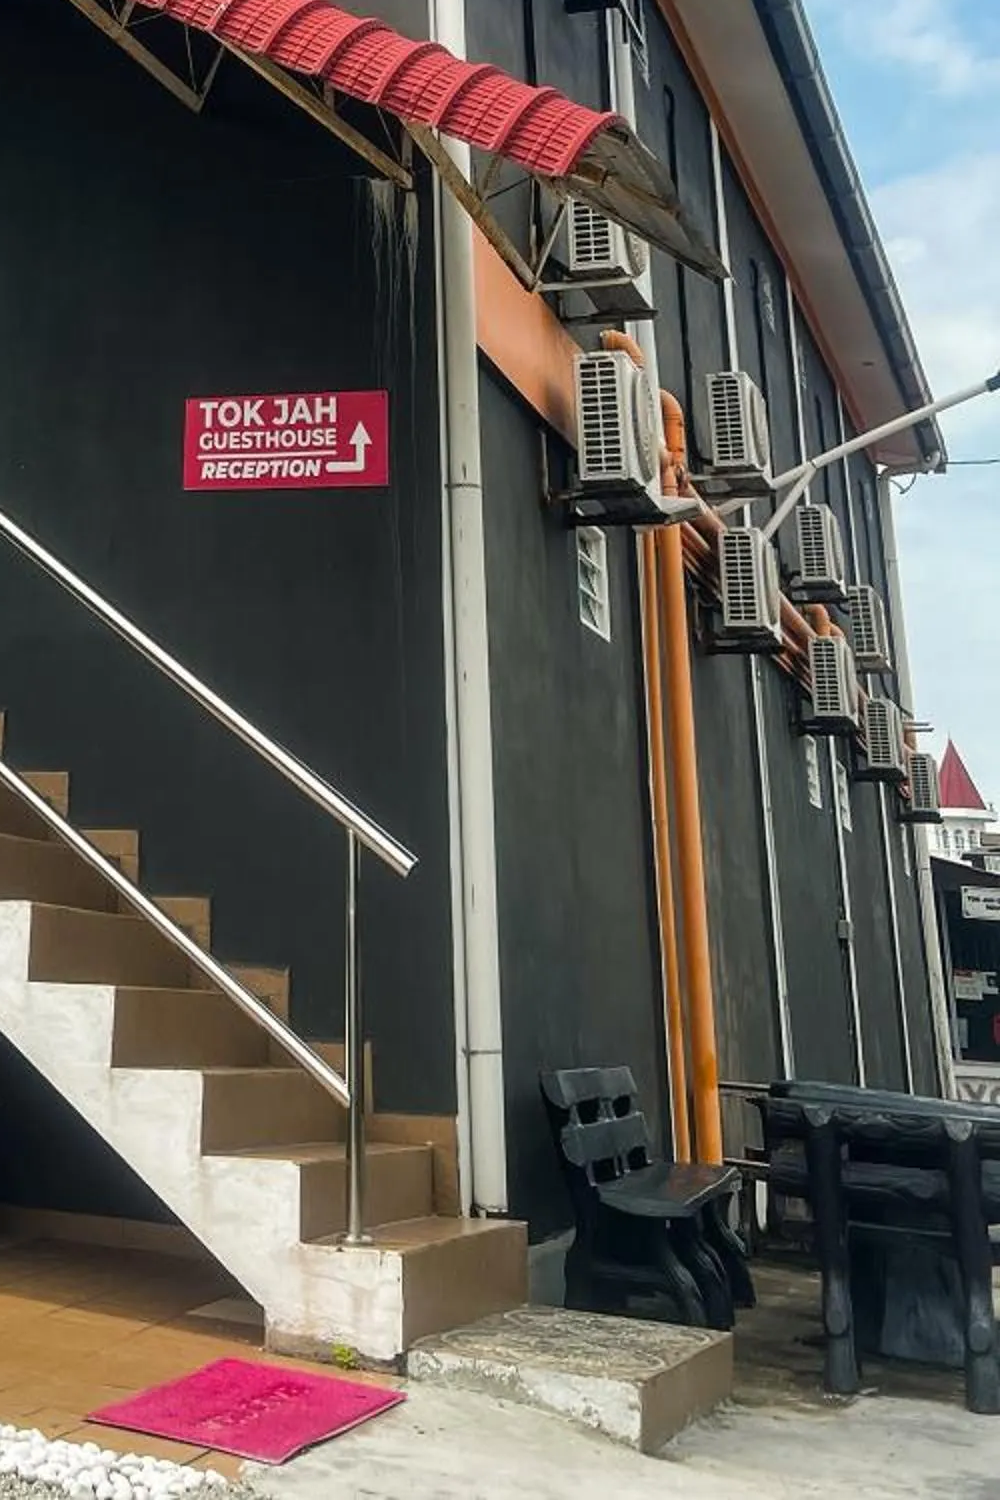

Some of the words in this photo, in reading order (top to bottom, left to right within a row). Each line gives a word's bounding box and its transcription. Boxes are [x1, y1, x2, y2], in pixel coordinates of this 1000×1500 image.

[199, 400, 265, 429] TOK
[271, 396, 337, 425] JAH
[199, 428, 337, 450] GUESTHOUSE
[201, 459, 322, 480] RECEPTION
